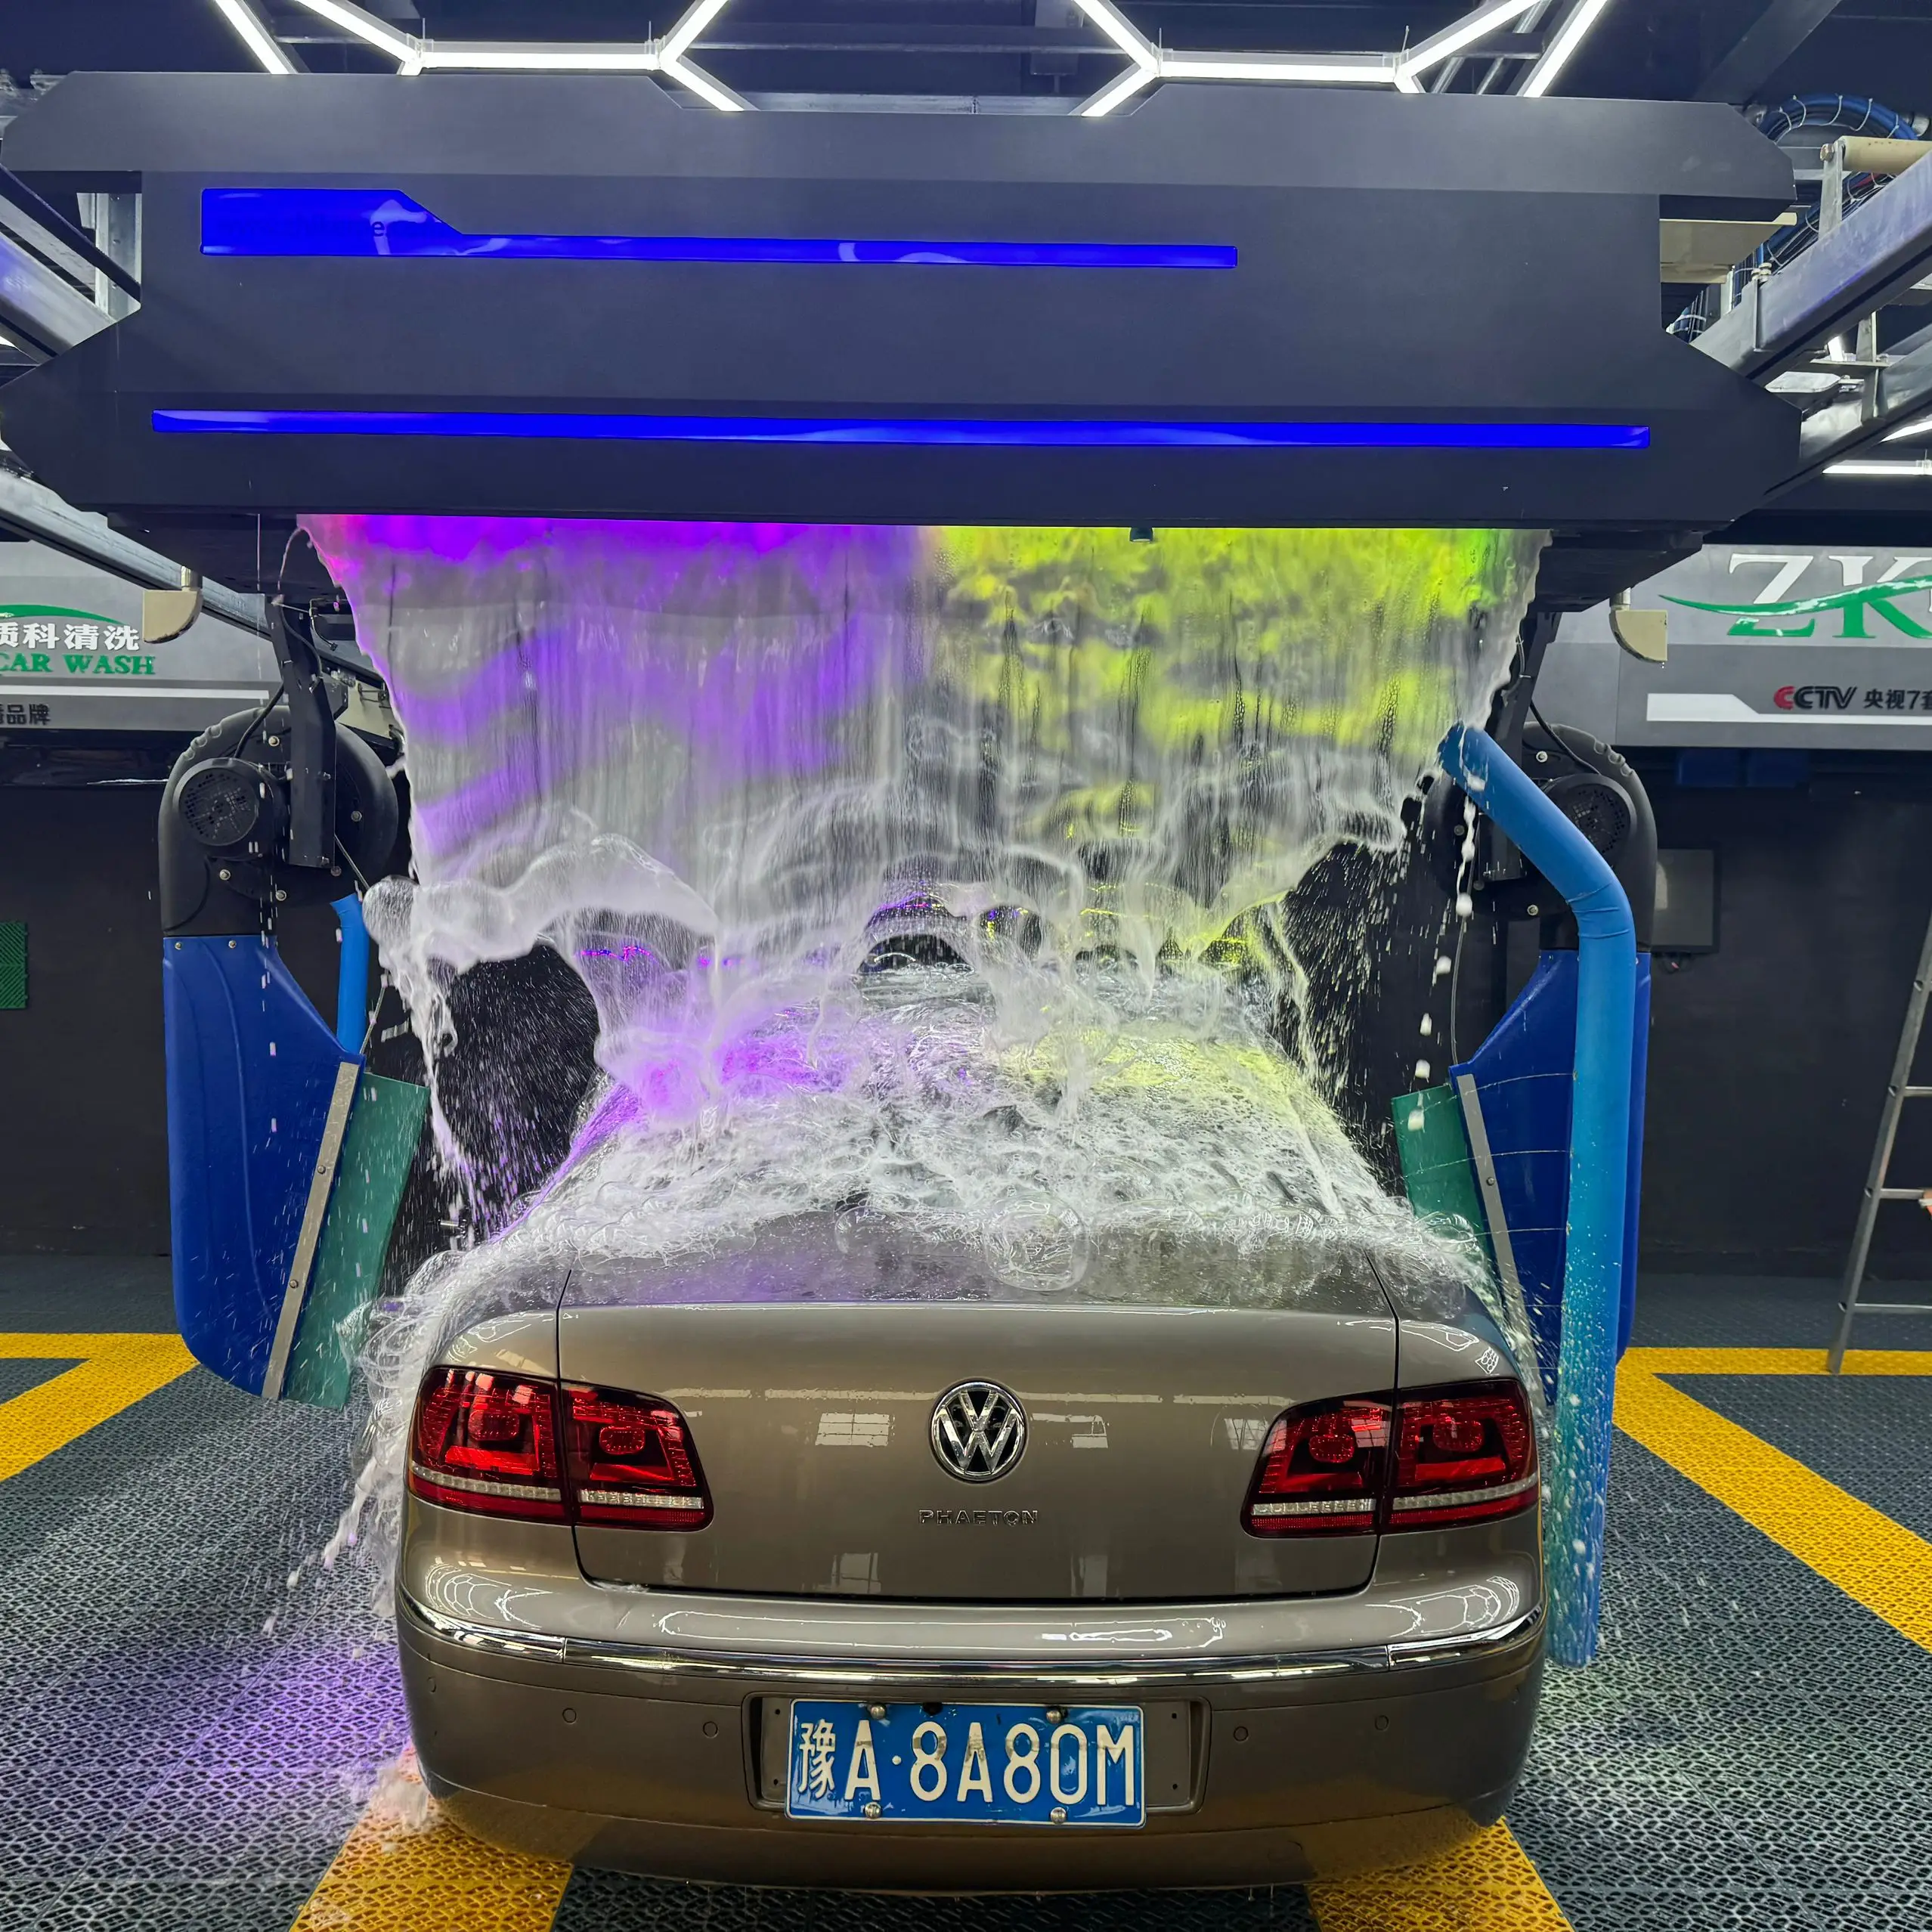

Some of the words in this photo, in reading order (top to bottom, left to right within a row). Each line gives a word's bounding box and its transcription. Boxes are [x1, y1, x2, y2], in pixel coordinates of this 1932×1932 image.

[63, 655, 156, 675] WASH
[1773, 686, 1858, 711] CCTV
[0, 704, 51, 726] 品牌
[918, 1509, 1038, 1525] PHAETON
